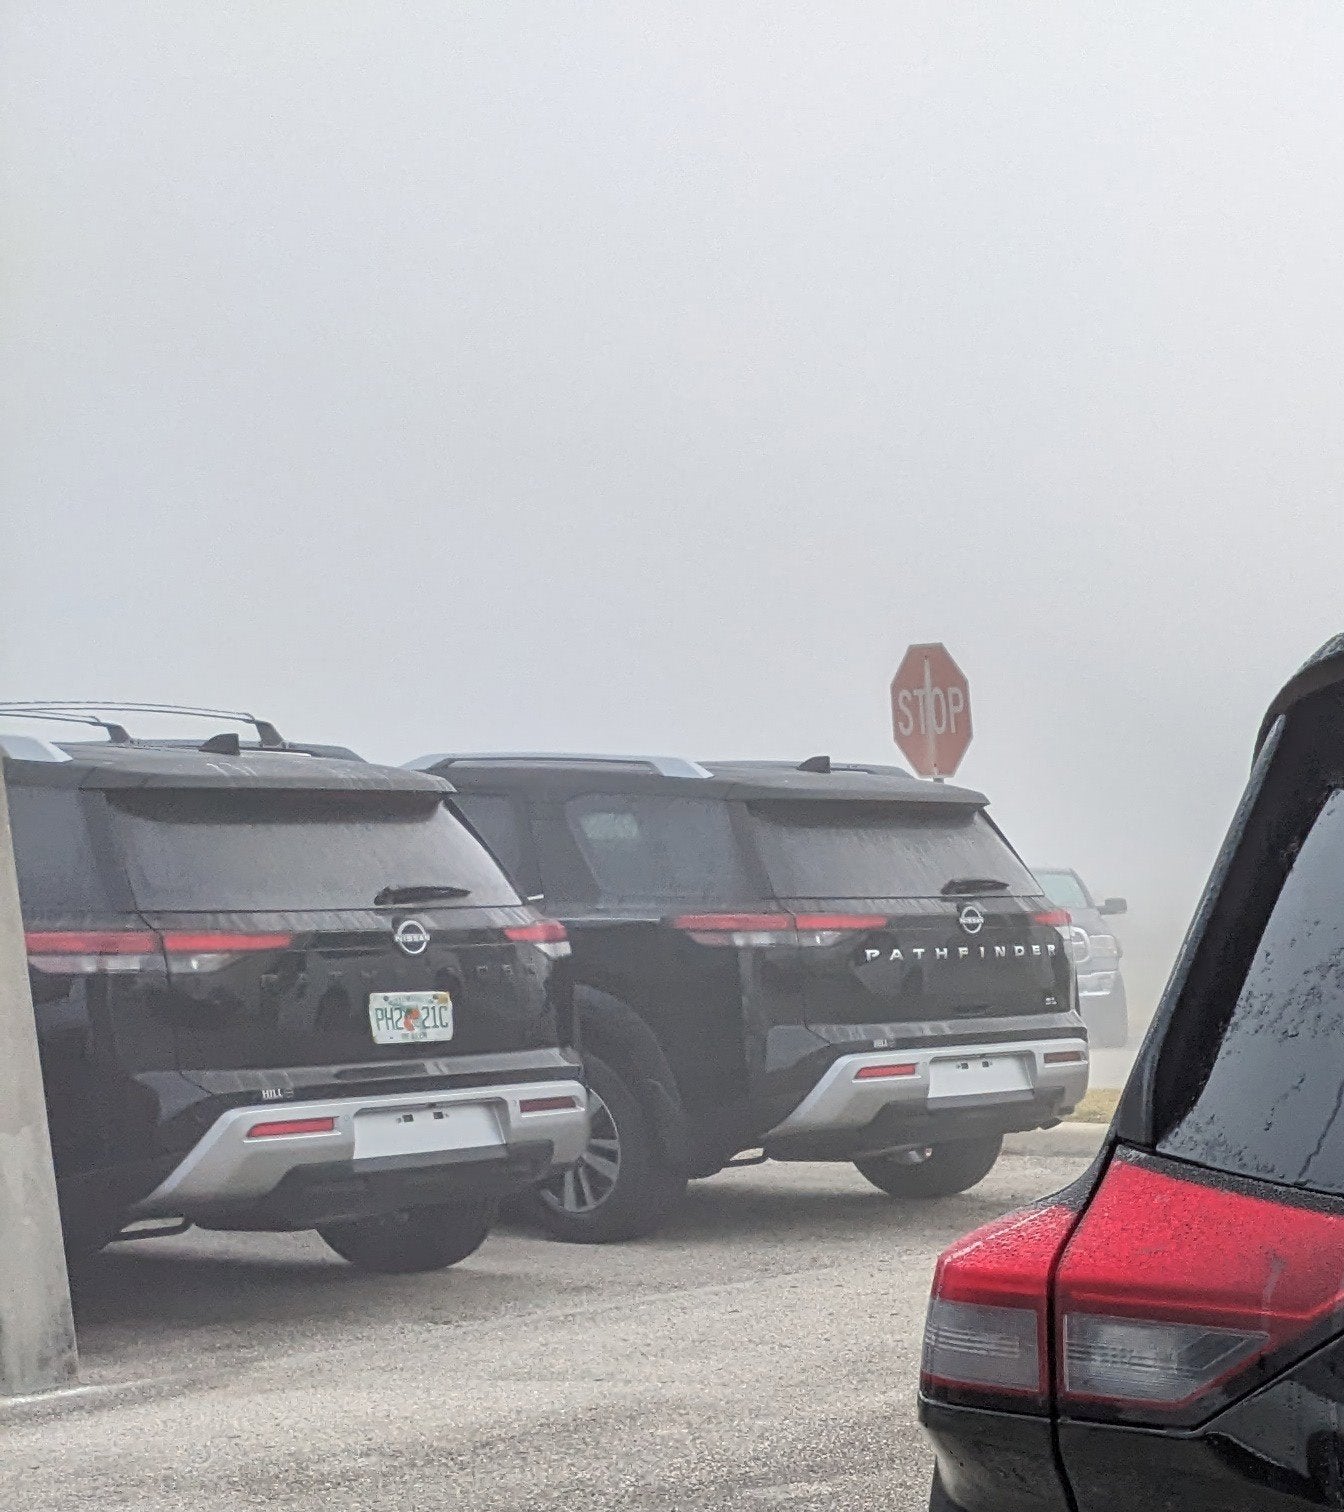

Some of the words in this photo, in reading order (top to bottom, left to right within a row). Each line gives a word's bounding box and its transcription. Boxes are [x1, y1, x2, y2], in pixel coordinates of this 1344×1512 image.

[898, 687, 963, 736] STOP
[865, 944, 1056, 961] PATHFINDER
[262, 1089, 283, 1099] HILL
